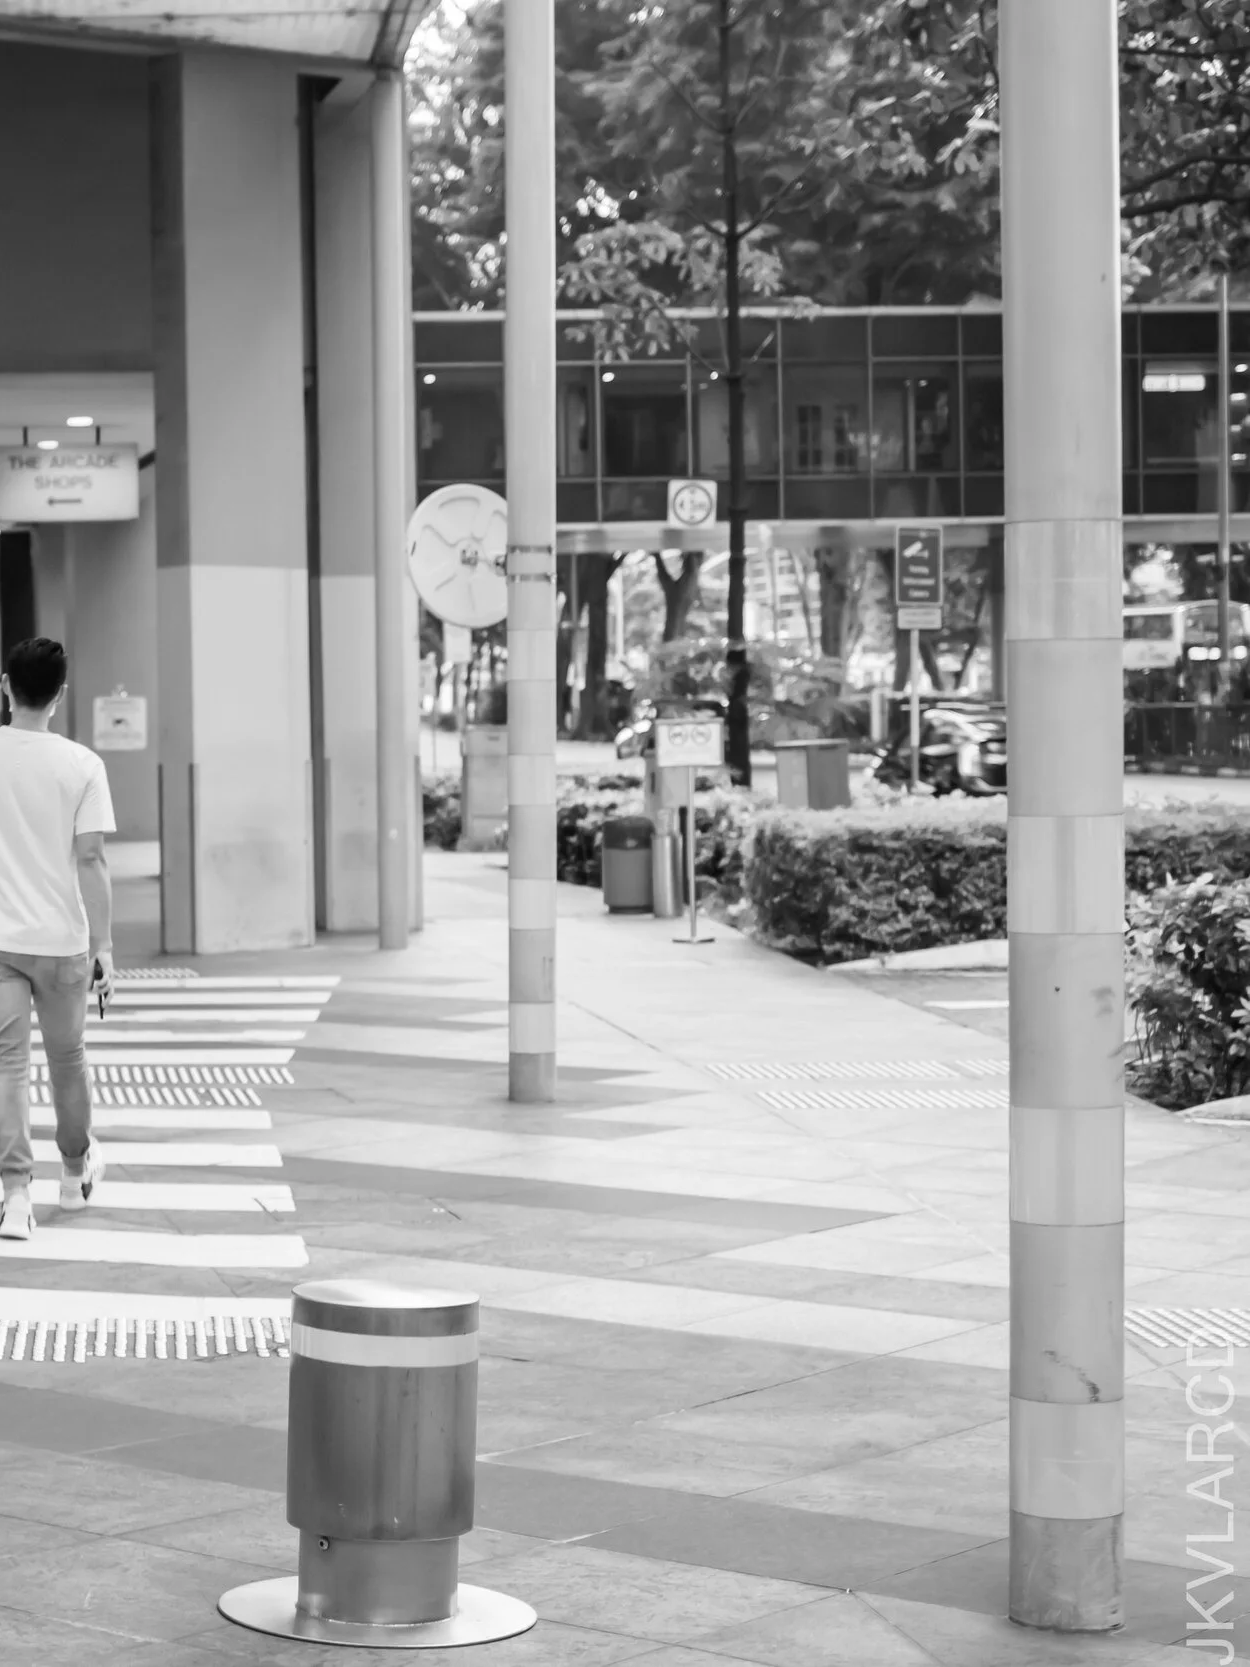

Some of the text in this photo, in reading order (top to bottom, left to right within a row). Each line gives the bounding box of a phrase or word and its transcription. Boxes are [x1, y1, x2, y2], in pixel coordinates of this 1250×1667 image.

[8, 453, 119, 469] THE ARCADE
[34, 475, 93, 490] SHOPS
